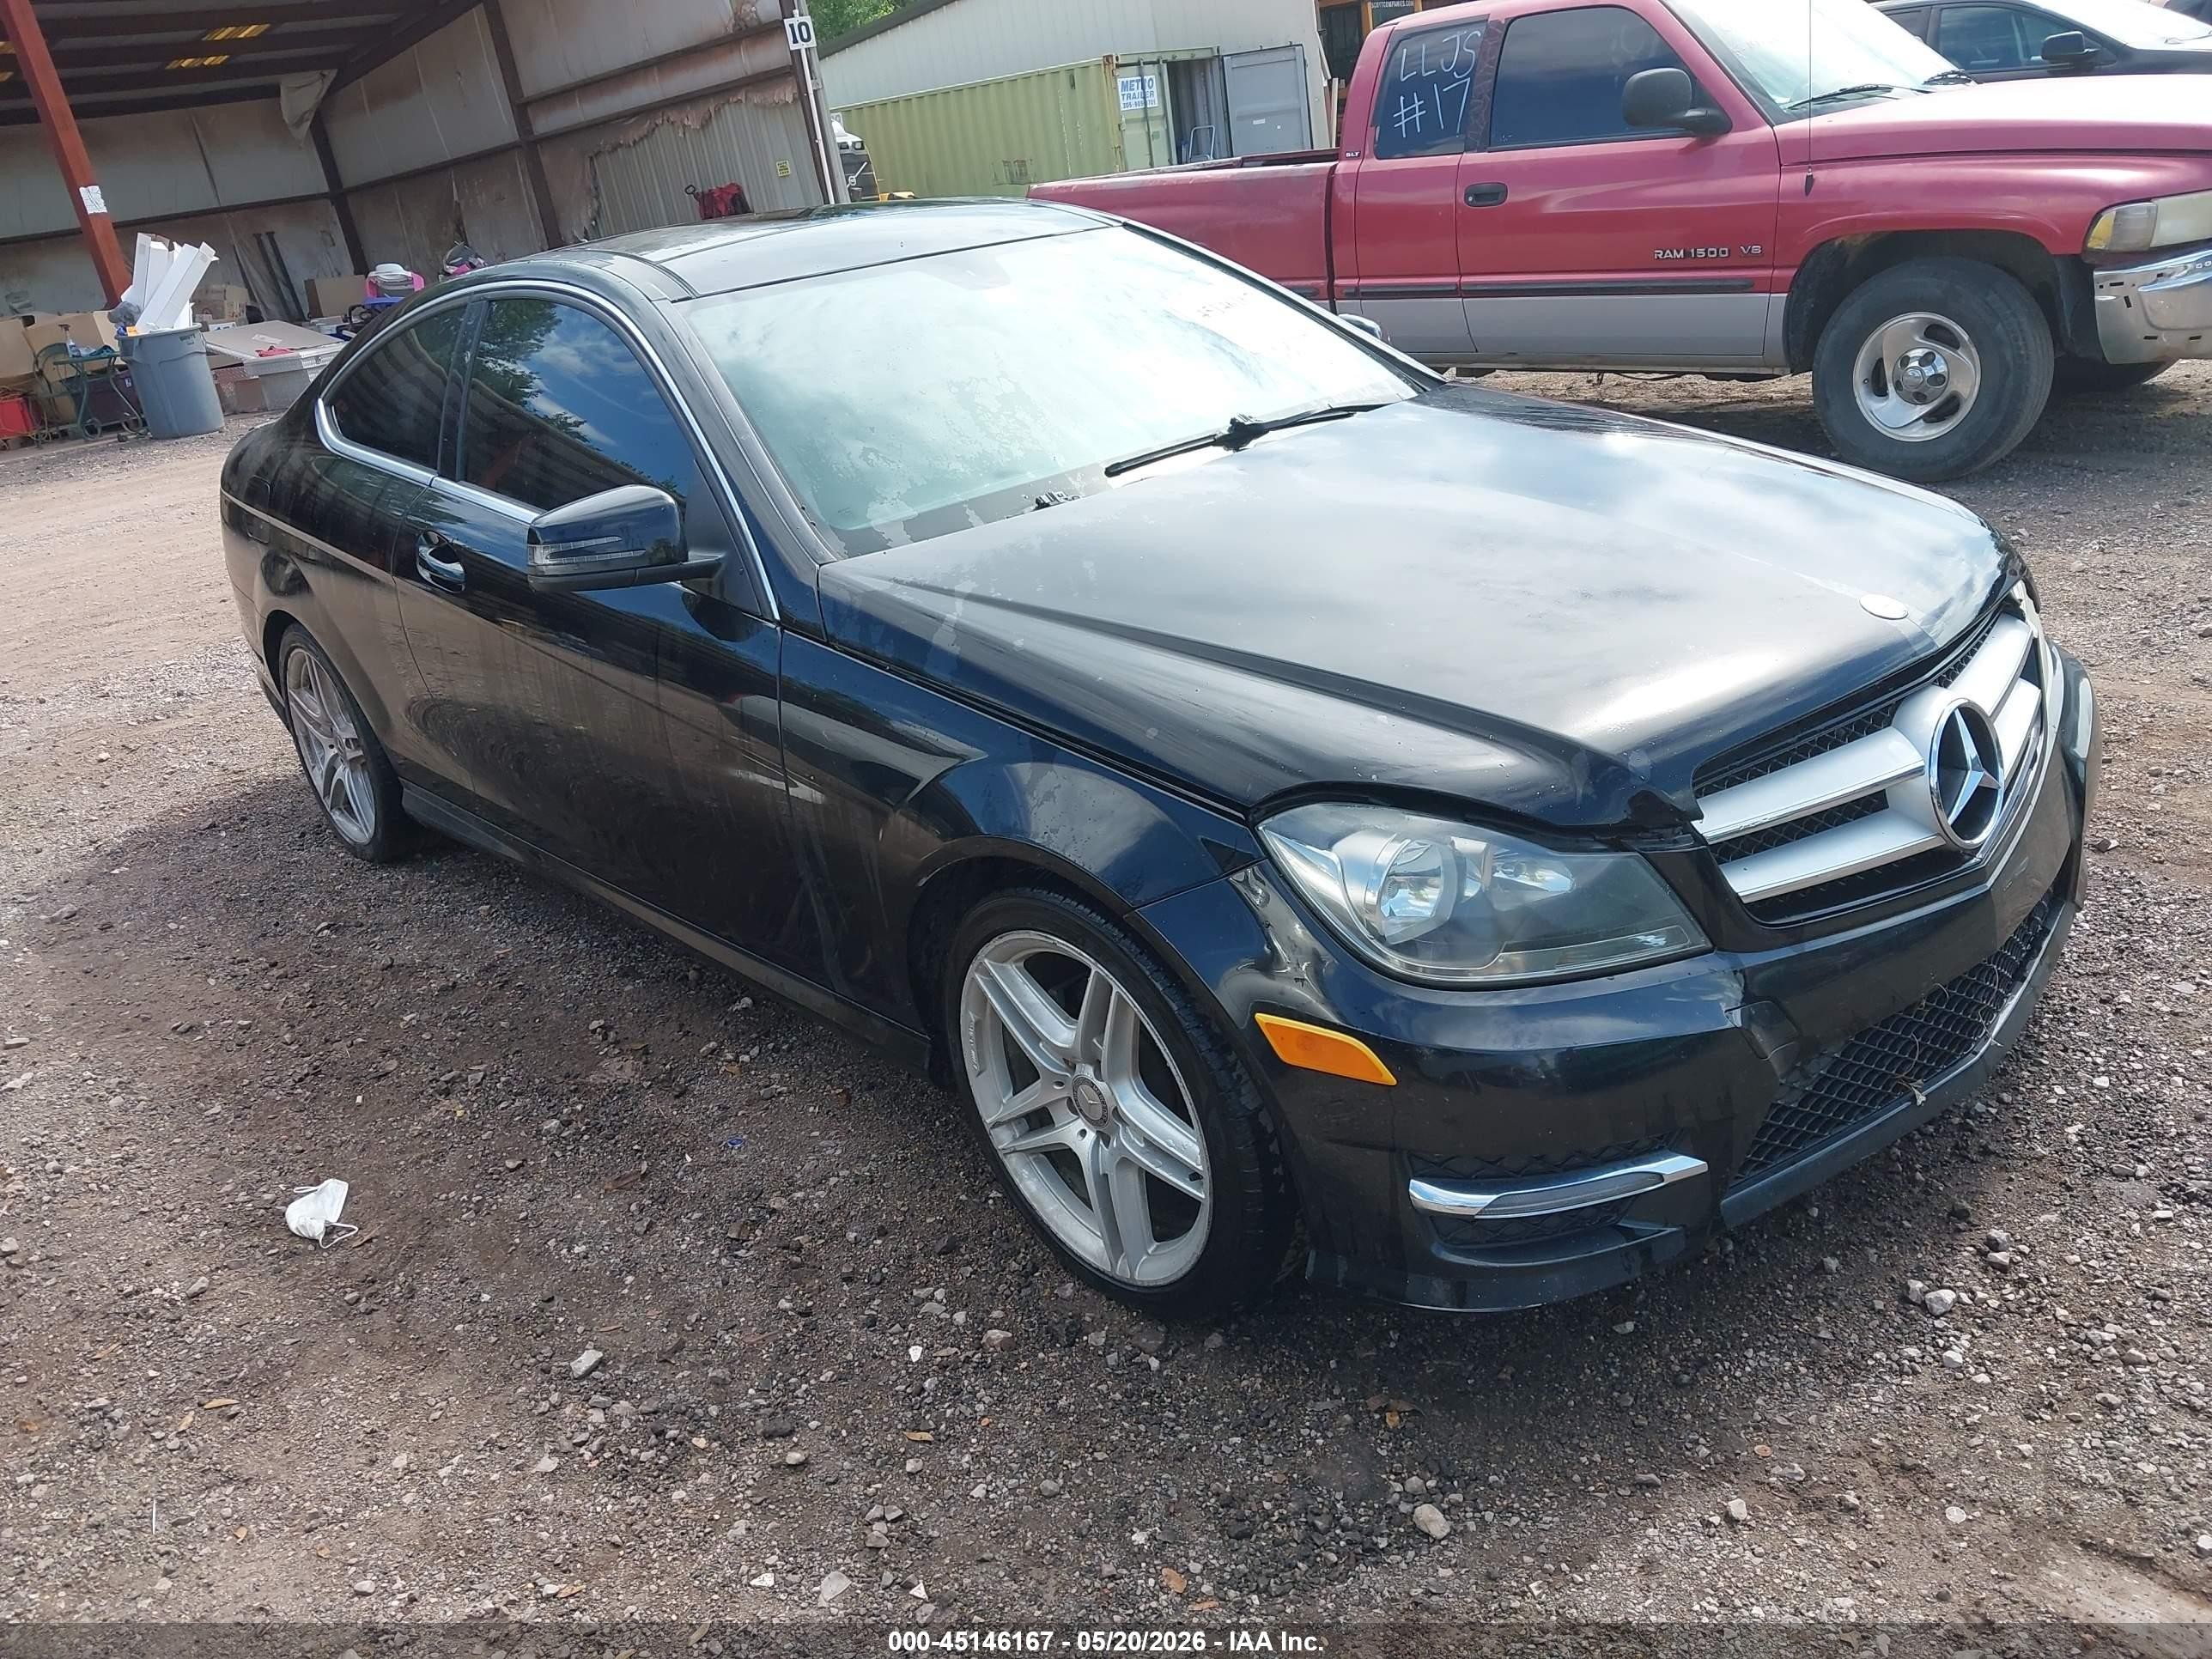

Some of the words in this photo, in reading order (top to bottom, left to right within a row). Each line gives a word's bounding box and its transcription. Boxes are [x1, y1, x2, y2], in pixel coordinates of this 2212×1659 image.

[788, 21, 811, 44] 10
[1393, 77, 1471, 137] #17
[1654, 249, 1685, 259] RAM
[1690, 247, 1729, 258] 1500
[1740, 245, 1762, 254] V8
